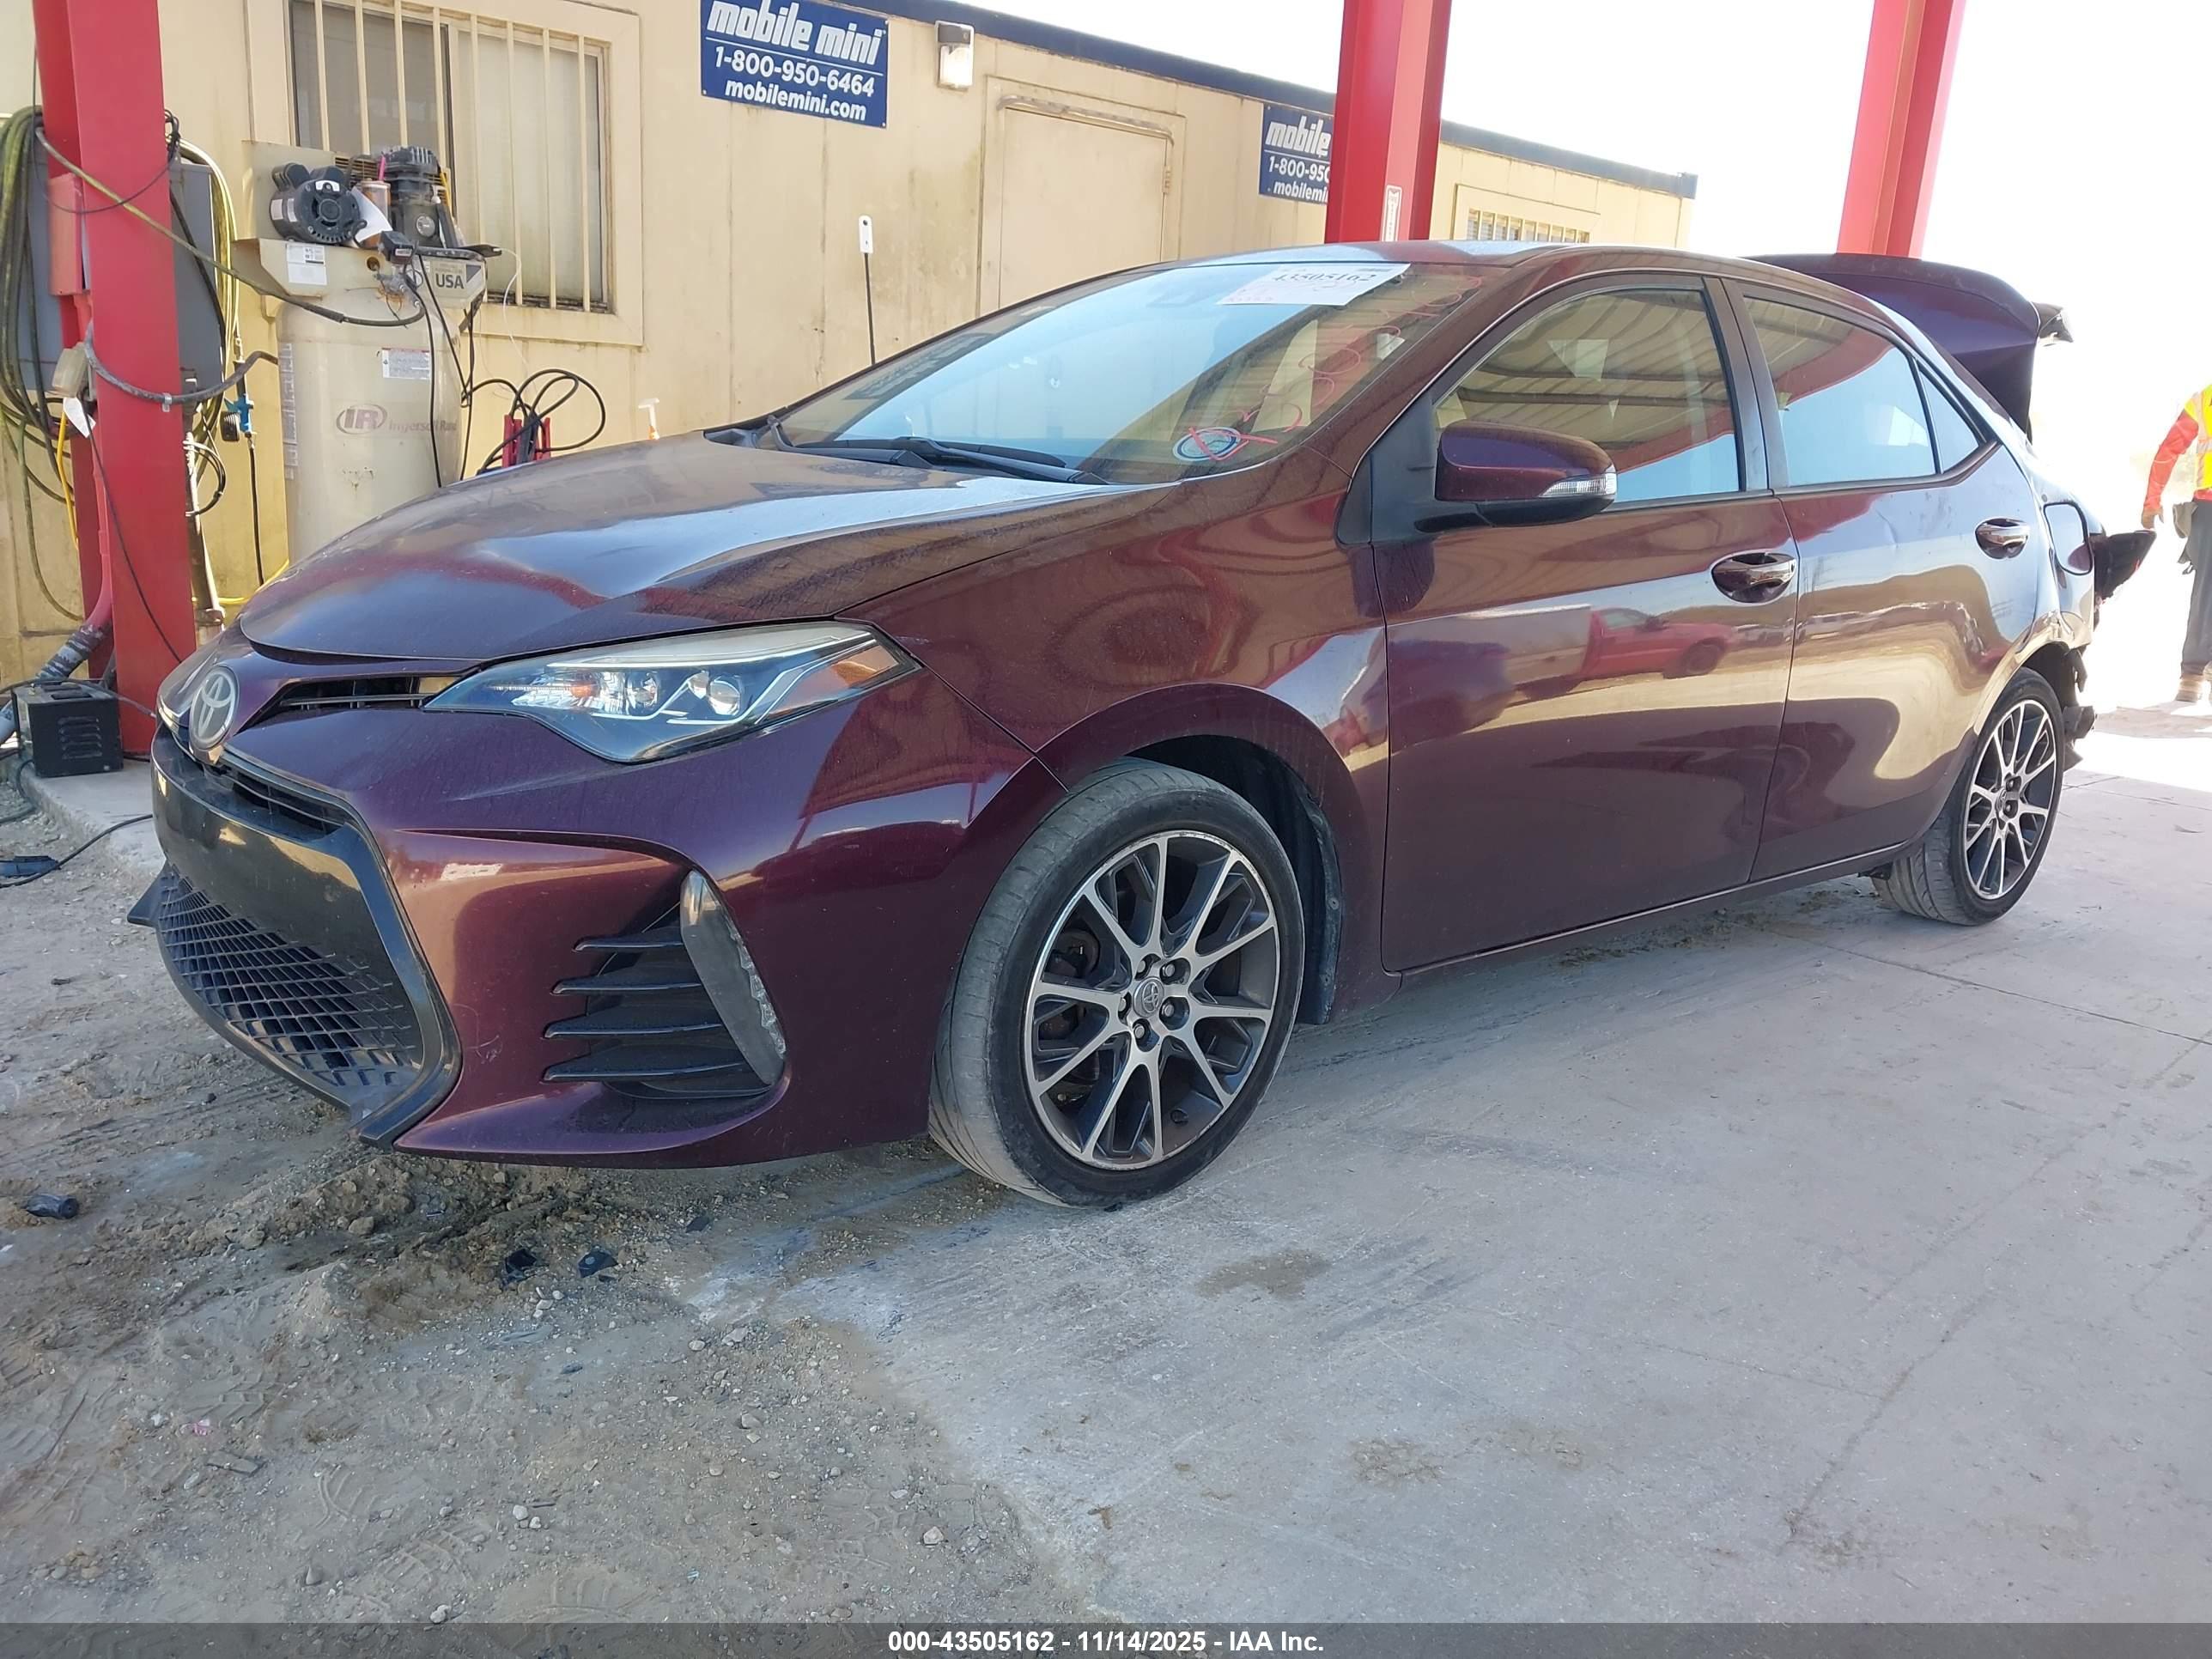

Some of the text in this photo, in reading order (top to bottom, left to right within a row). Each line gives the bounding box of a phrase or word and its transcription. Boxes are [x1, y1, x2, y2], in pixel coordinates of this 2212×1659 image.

[707, 0, 883, 65] mobile mini
[715, 46, 875, 97] 1-800-950-6464
[725, 79, 867, 121] mobilemini.com
[1265, 115, 1332, 156] mobile
[435, 273, 465, 289] USA
